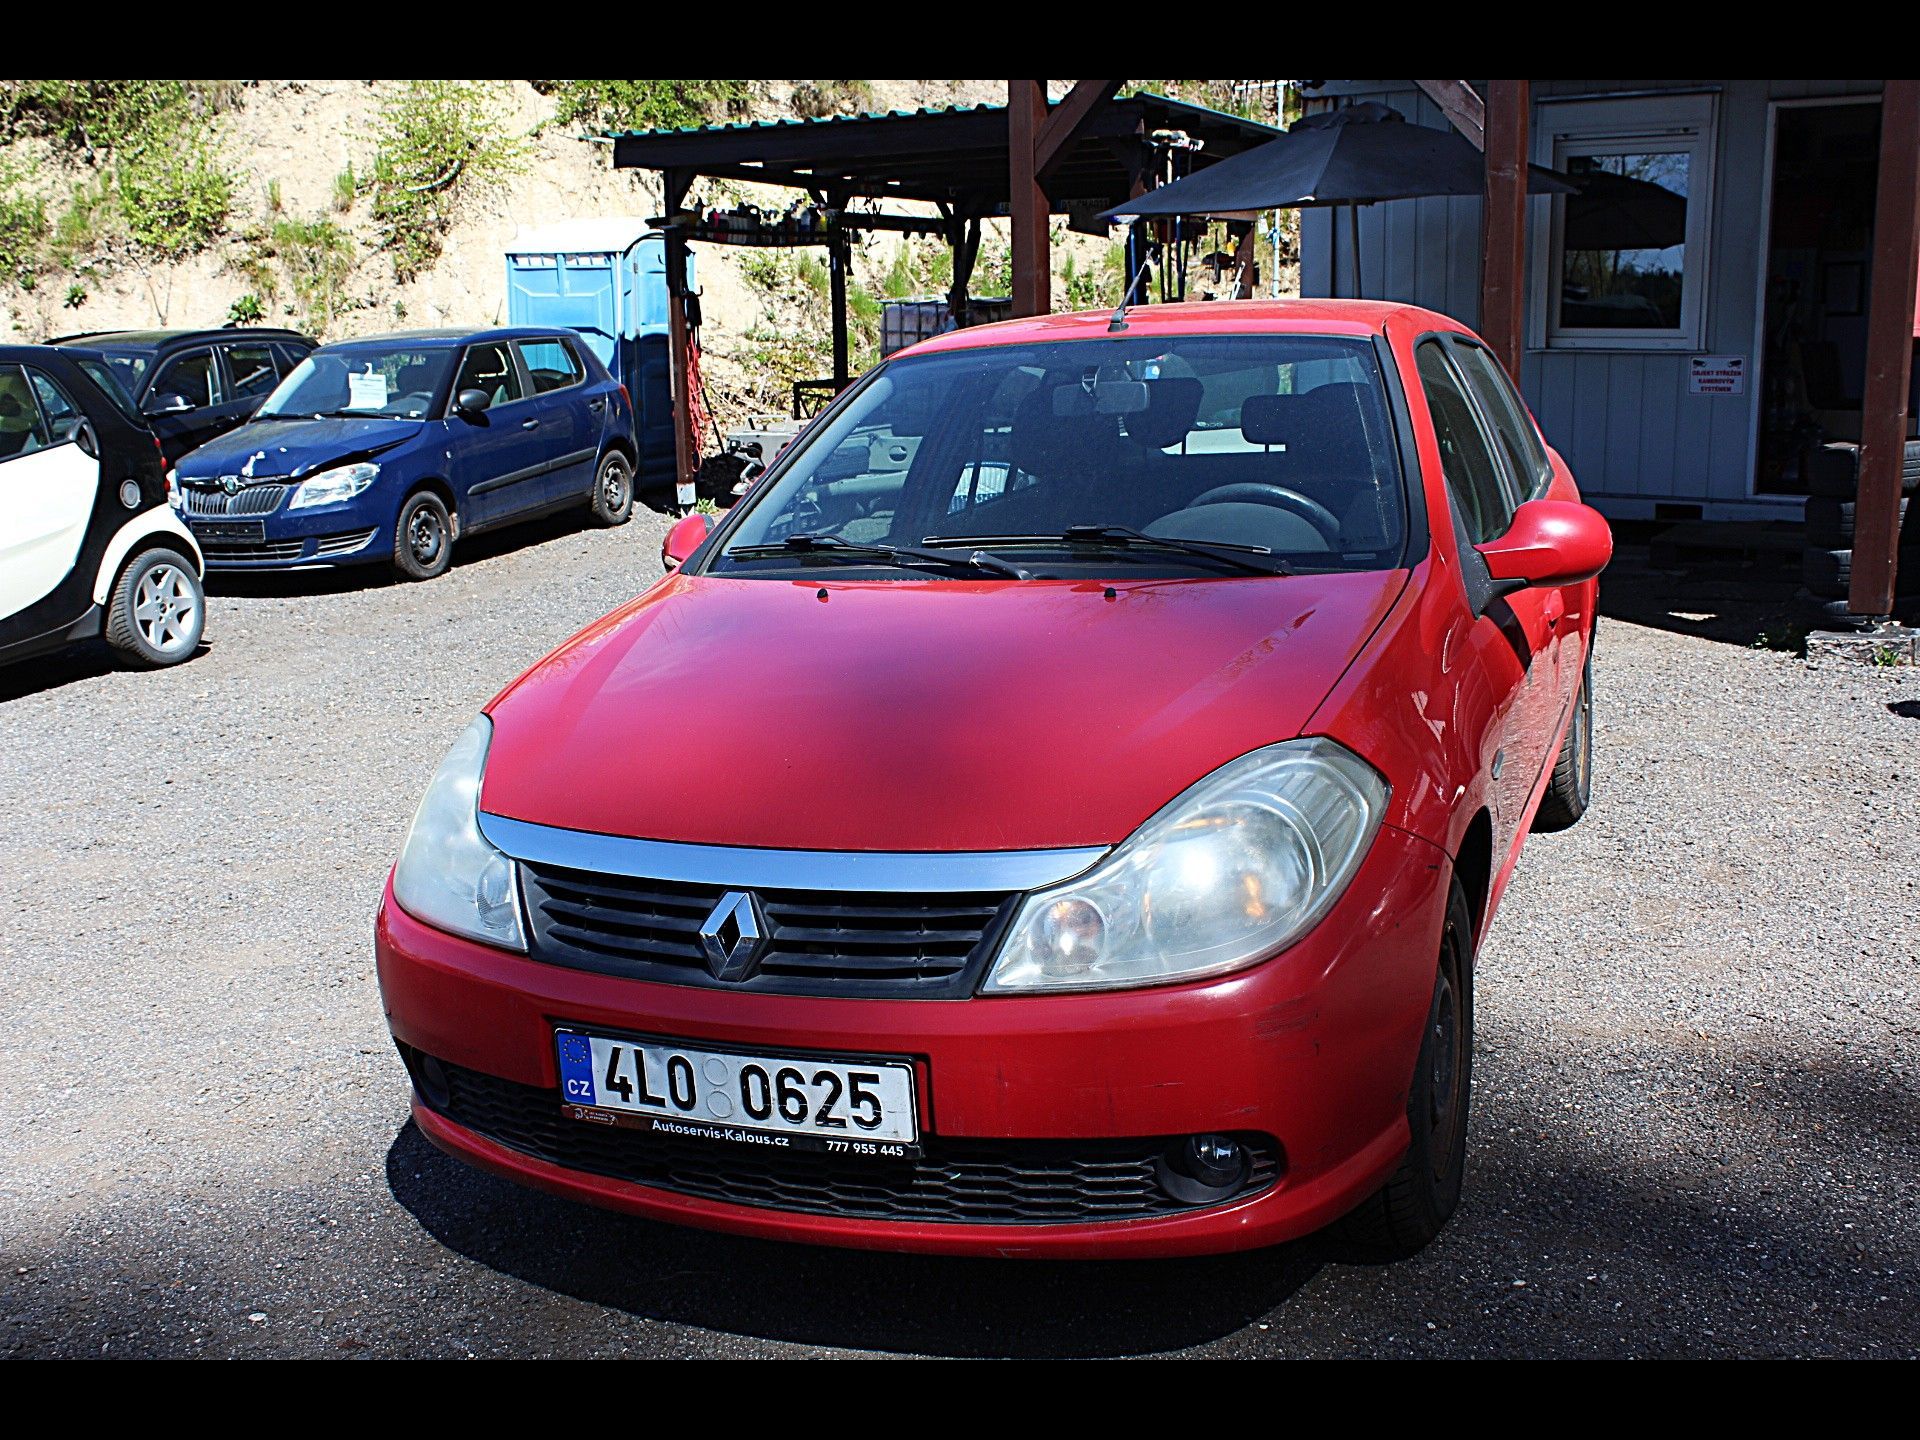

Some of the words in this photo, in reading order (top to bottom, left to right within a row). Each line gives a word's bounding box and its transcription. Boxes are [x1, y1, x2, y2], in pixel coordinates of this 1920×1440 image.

[567, 1078, 591, 1096] CZ
[739, 1063, 885, 1130] 0625
[651, 1118, 790, 1148] Autoservis-Kalous.cz
[826, 1140, 850, 1153] 777
[853, 1142, 877, 1155] 955
[880, 1144, 904, 1157] 445
